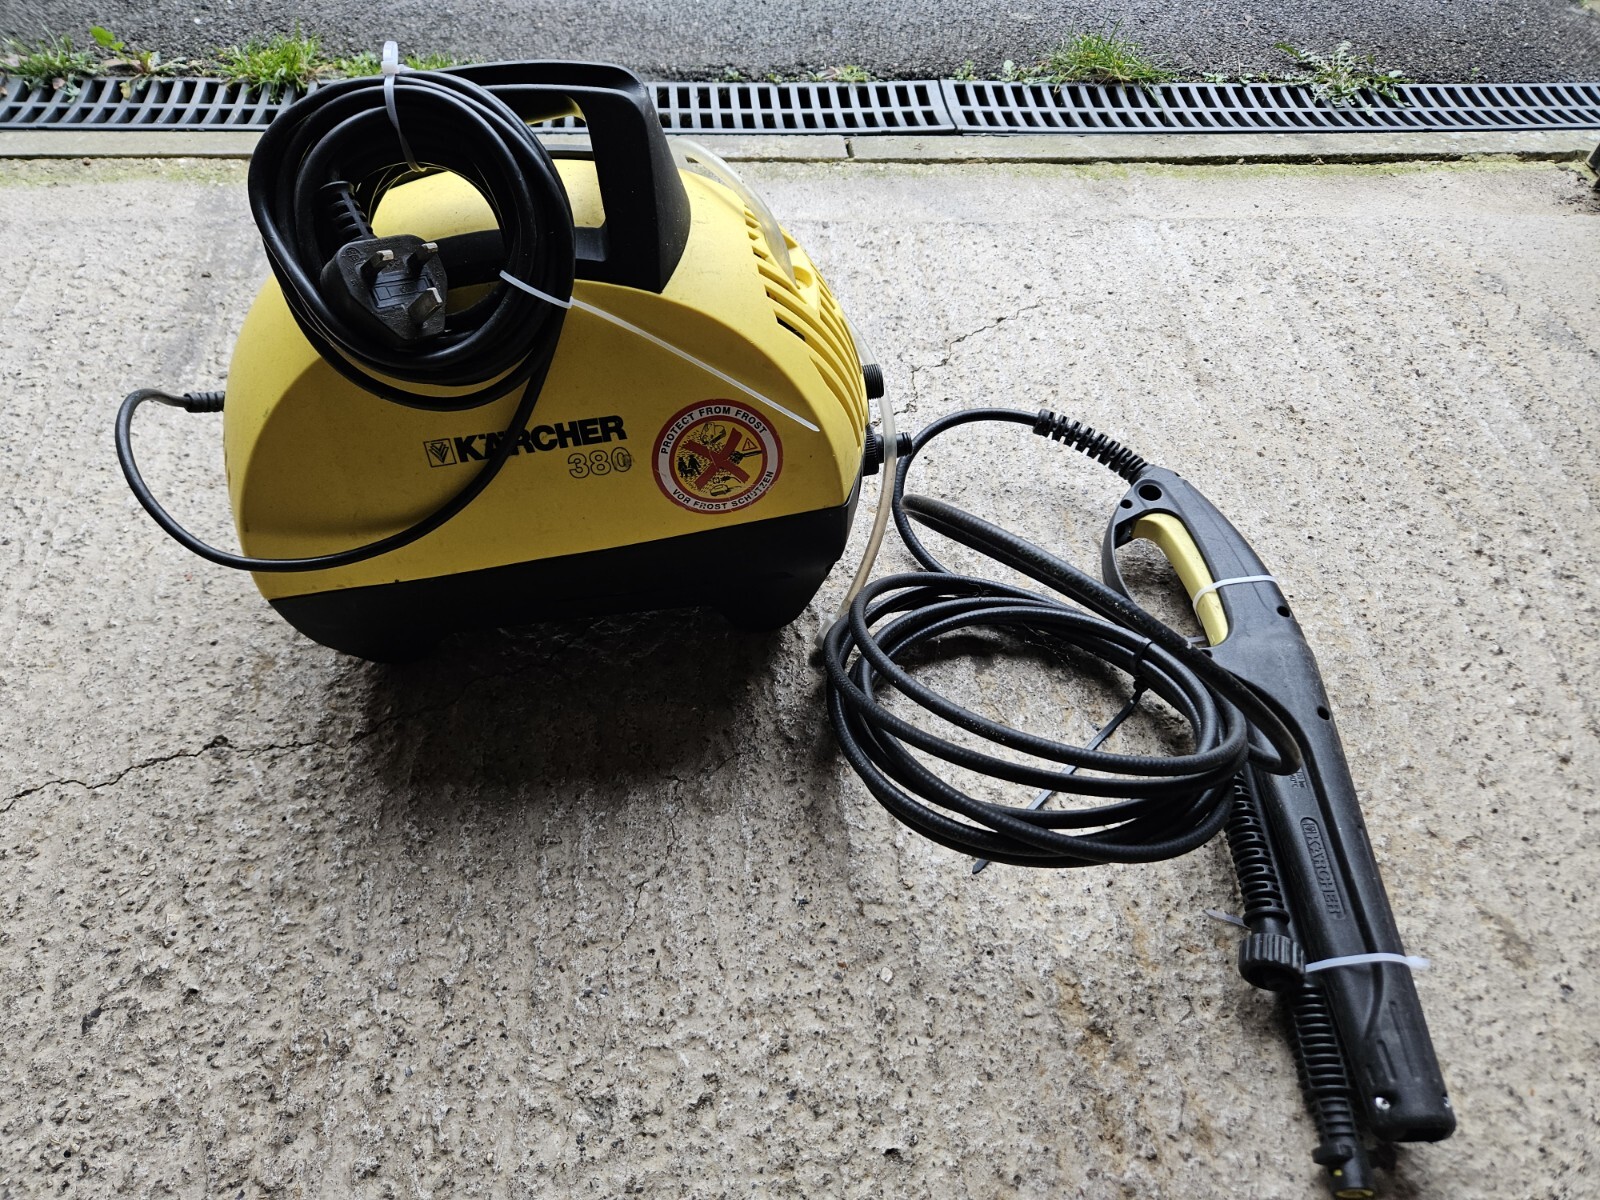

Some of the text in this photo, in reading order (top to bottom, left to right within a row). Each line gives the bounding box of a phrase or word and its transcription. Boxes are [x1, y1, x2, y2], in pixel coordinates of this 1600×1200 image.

[661, 406, 767, 454] PROTECT FROM FROST
[568, 446, 632, 479] 380
[672, 488, 692, 504] VOR
[693, 501, 728, 510] FROST
